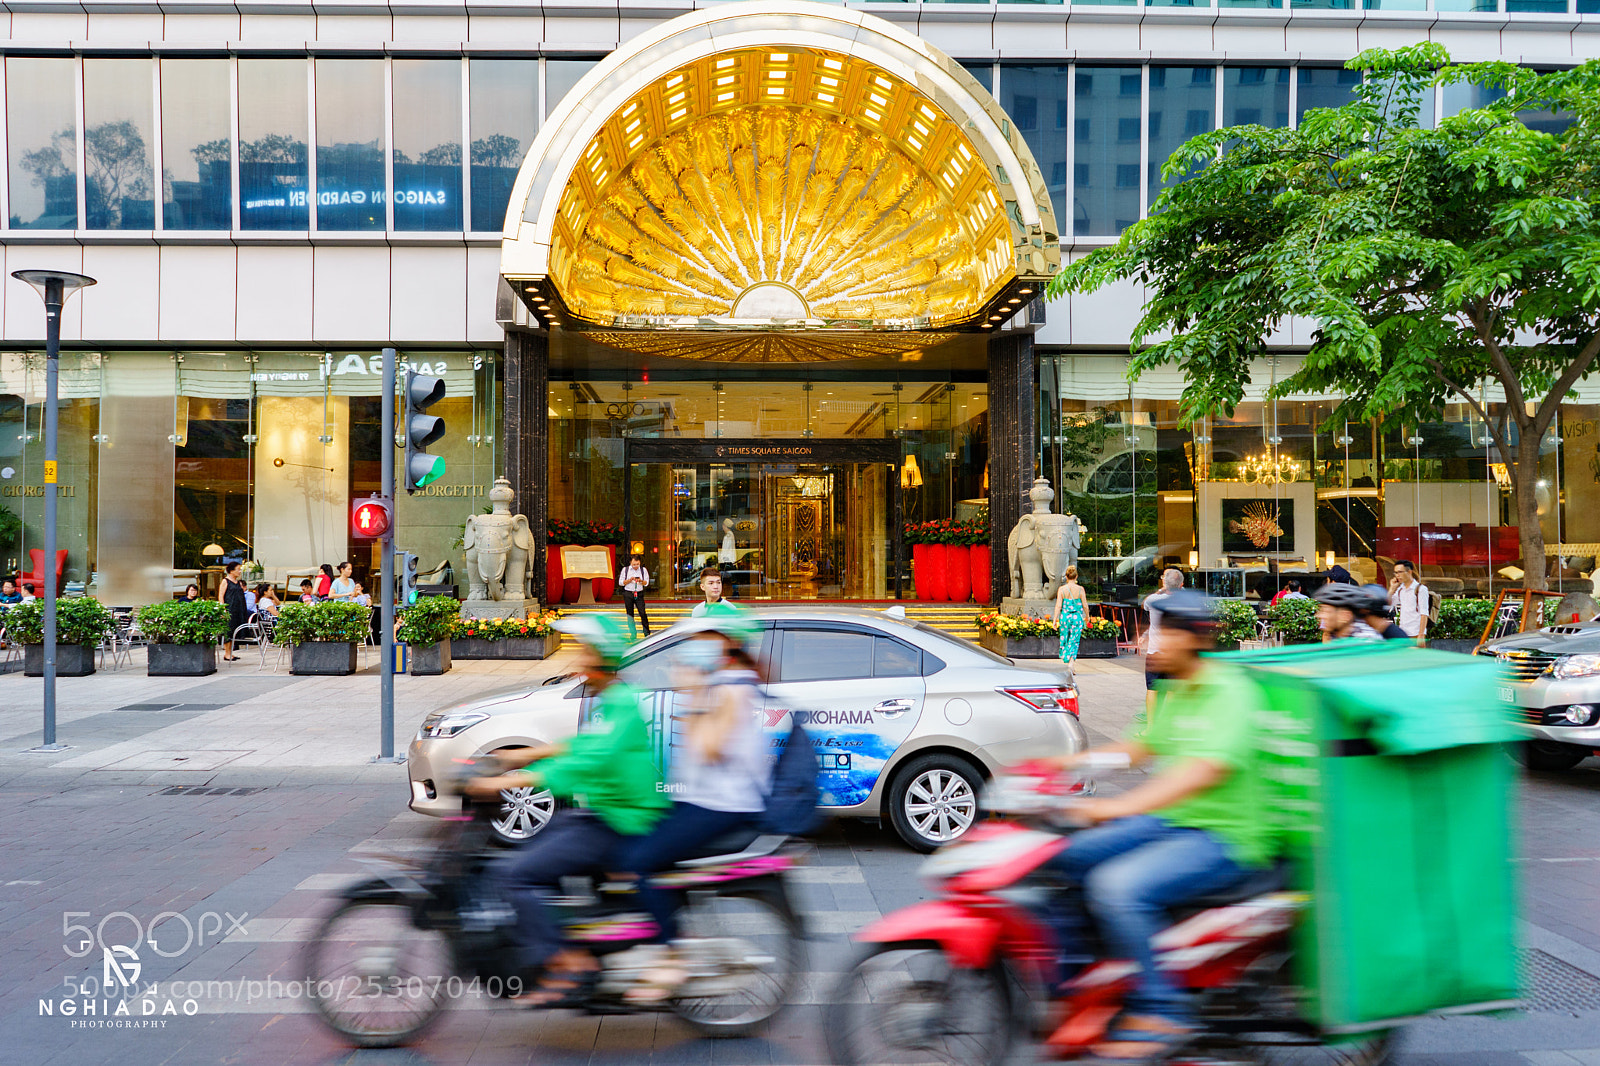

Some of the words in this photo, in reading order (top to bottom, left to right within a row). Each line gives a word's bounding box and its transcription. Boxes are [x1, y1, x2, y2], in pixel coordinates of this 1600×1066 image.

[728, 447, 750, 455] TIMES
[751, 447, 781, 456] SQUARE
[782, 447, 812, 455] SAIGON
[2, 485, 75, 498] GIORGTI
[655, 781, 688, 793] Earth
